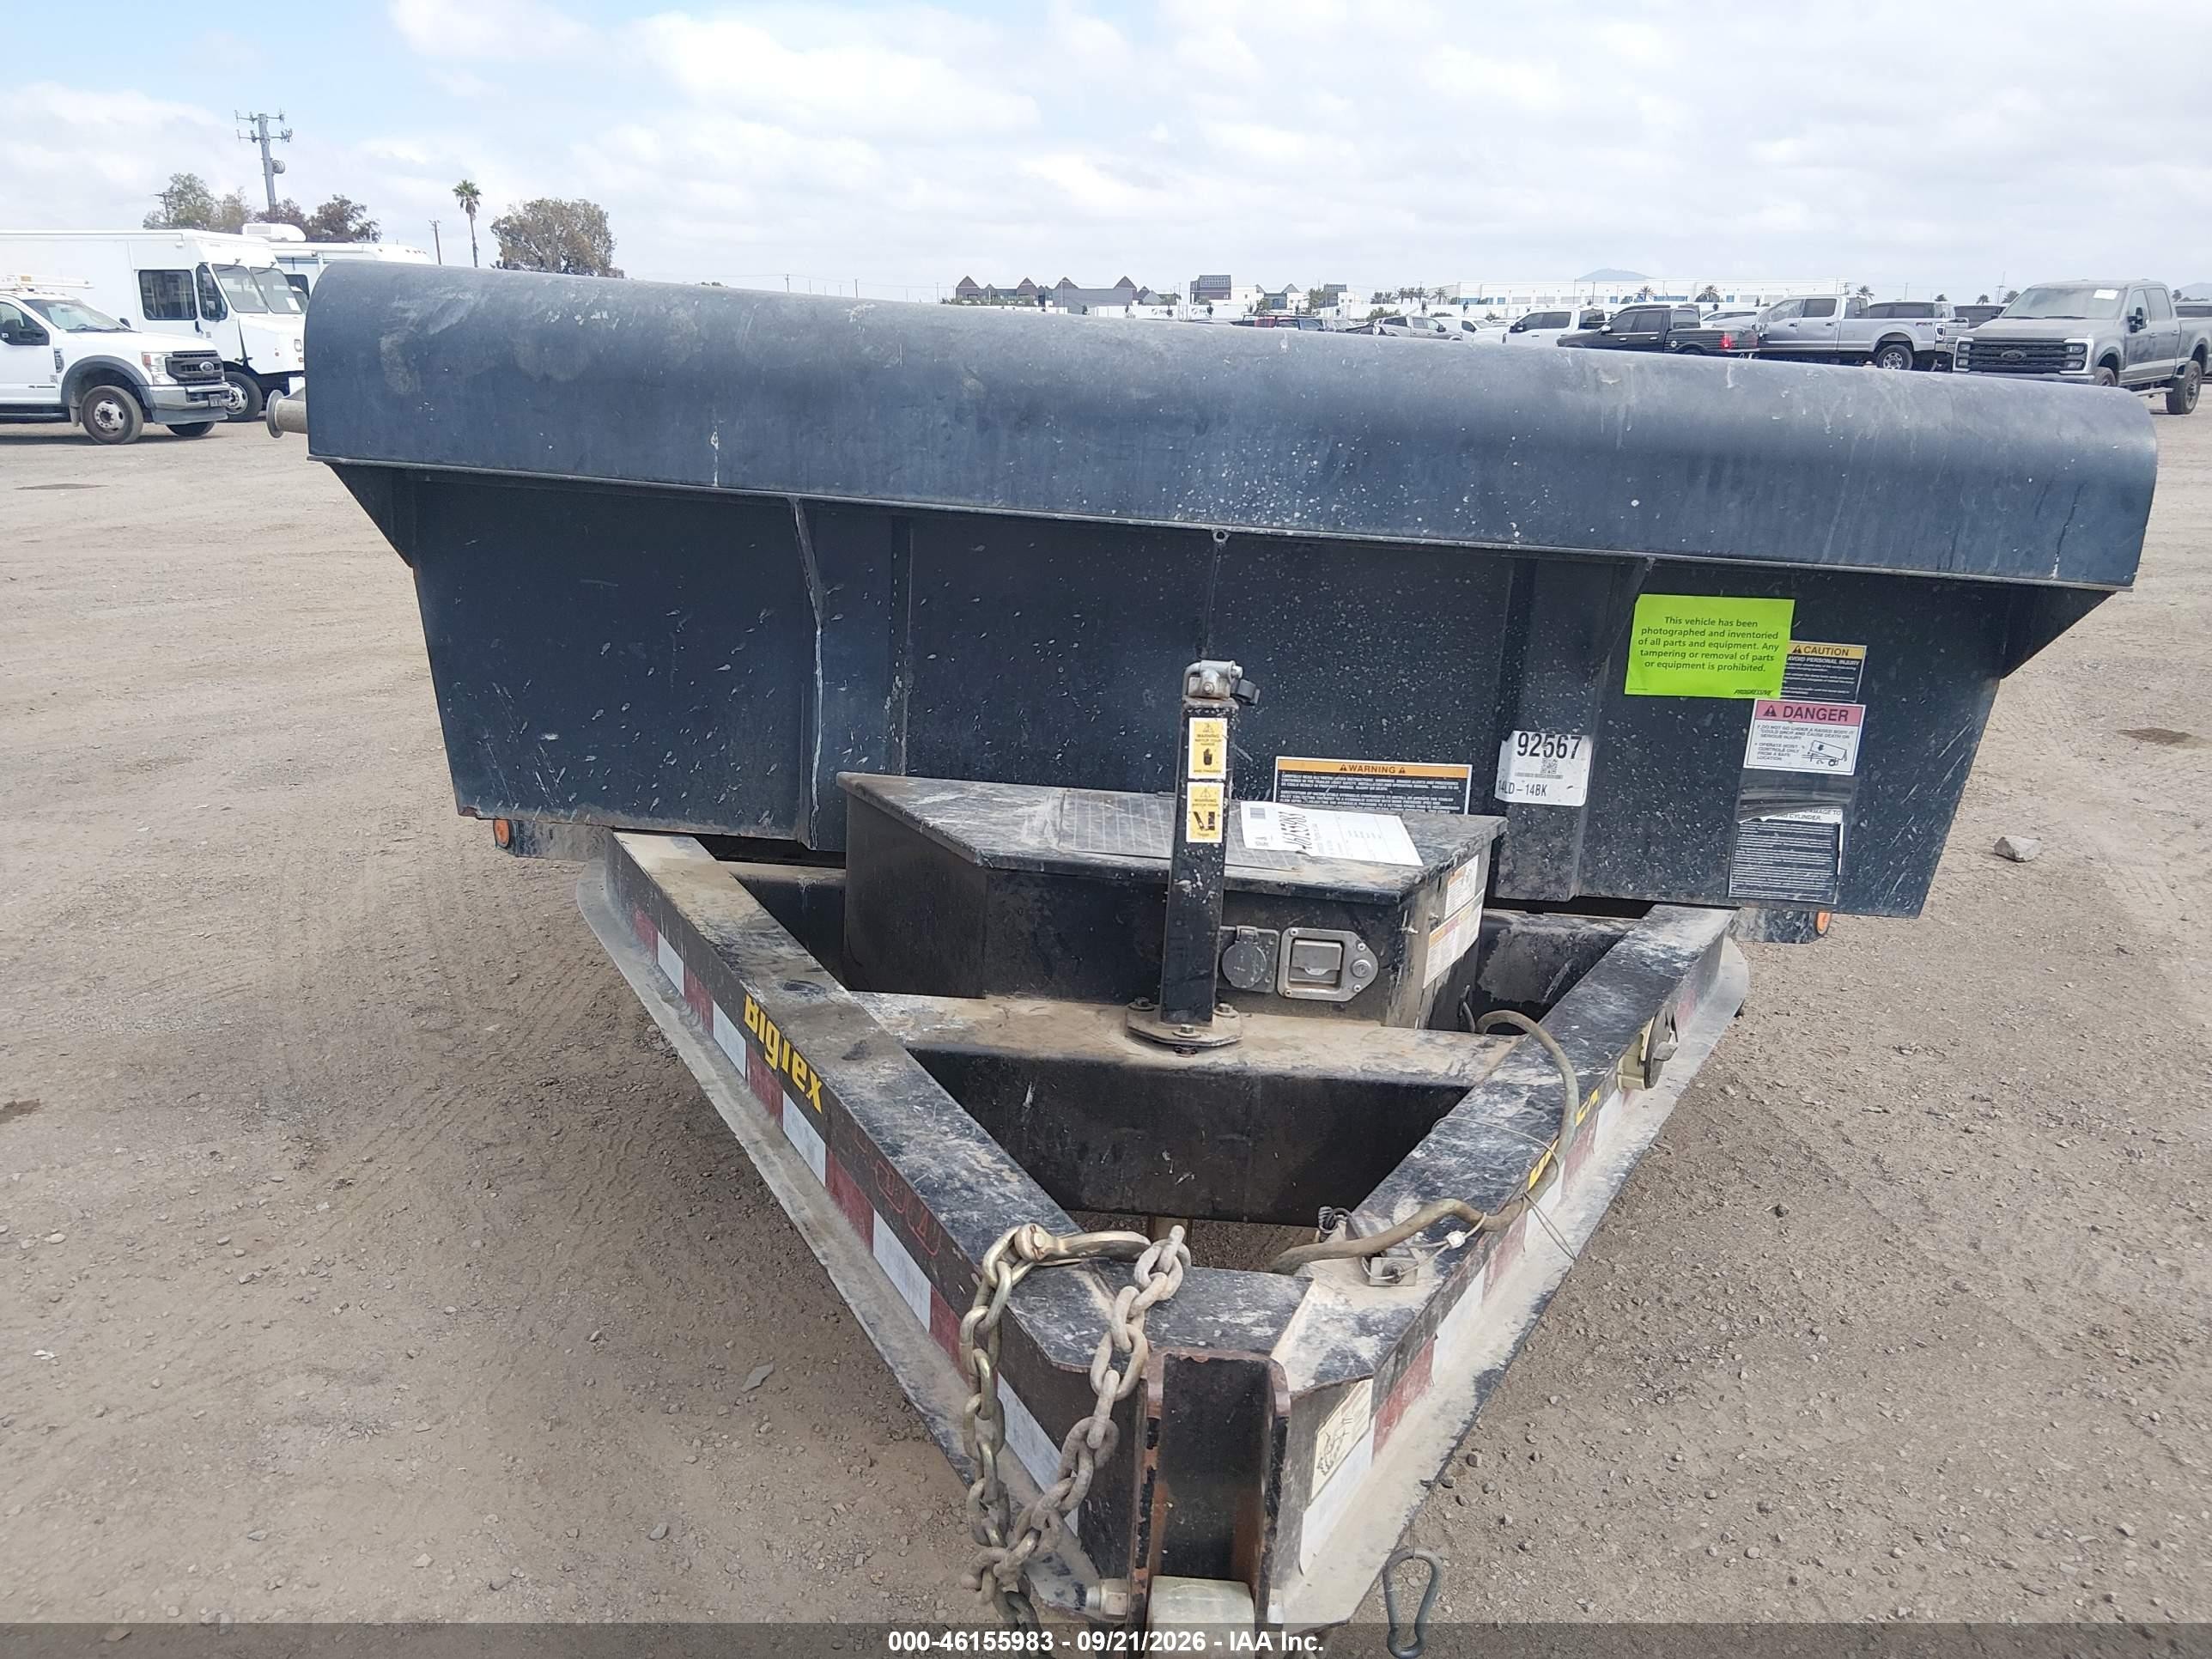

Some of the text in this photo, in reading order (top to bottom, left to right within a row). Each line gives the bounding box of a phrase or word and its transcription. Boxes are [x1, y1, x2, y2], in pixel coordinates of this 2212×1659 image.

[1685, 617, 1716, 626] vehicle
[1642, 627, 1705, 638] photographed
[1728, 630, 1778, 639] inventoried
[1663, 640, 1686, 648] parts
[1708, 641, 1759, 652] equipment.
[1762, 643, 1778, 652] Any
[1804, 646, 1849, 656] CAUTION
[1640, 649, 1686, 659] tampering
[1752, 653, 1774, 663] parts
[1656, 661, 1705, 671] equipment
[1717, 663, 1766, 672] prohibited.
[1783, 706, 1848, 721] DANGER
[1517, 732, 1582, 759] 92567
[1349, 764, 1395, 774] WARNING
